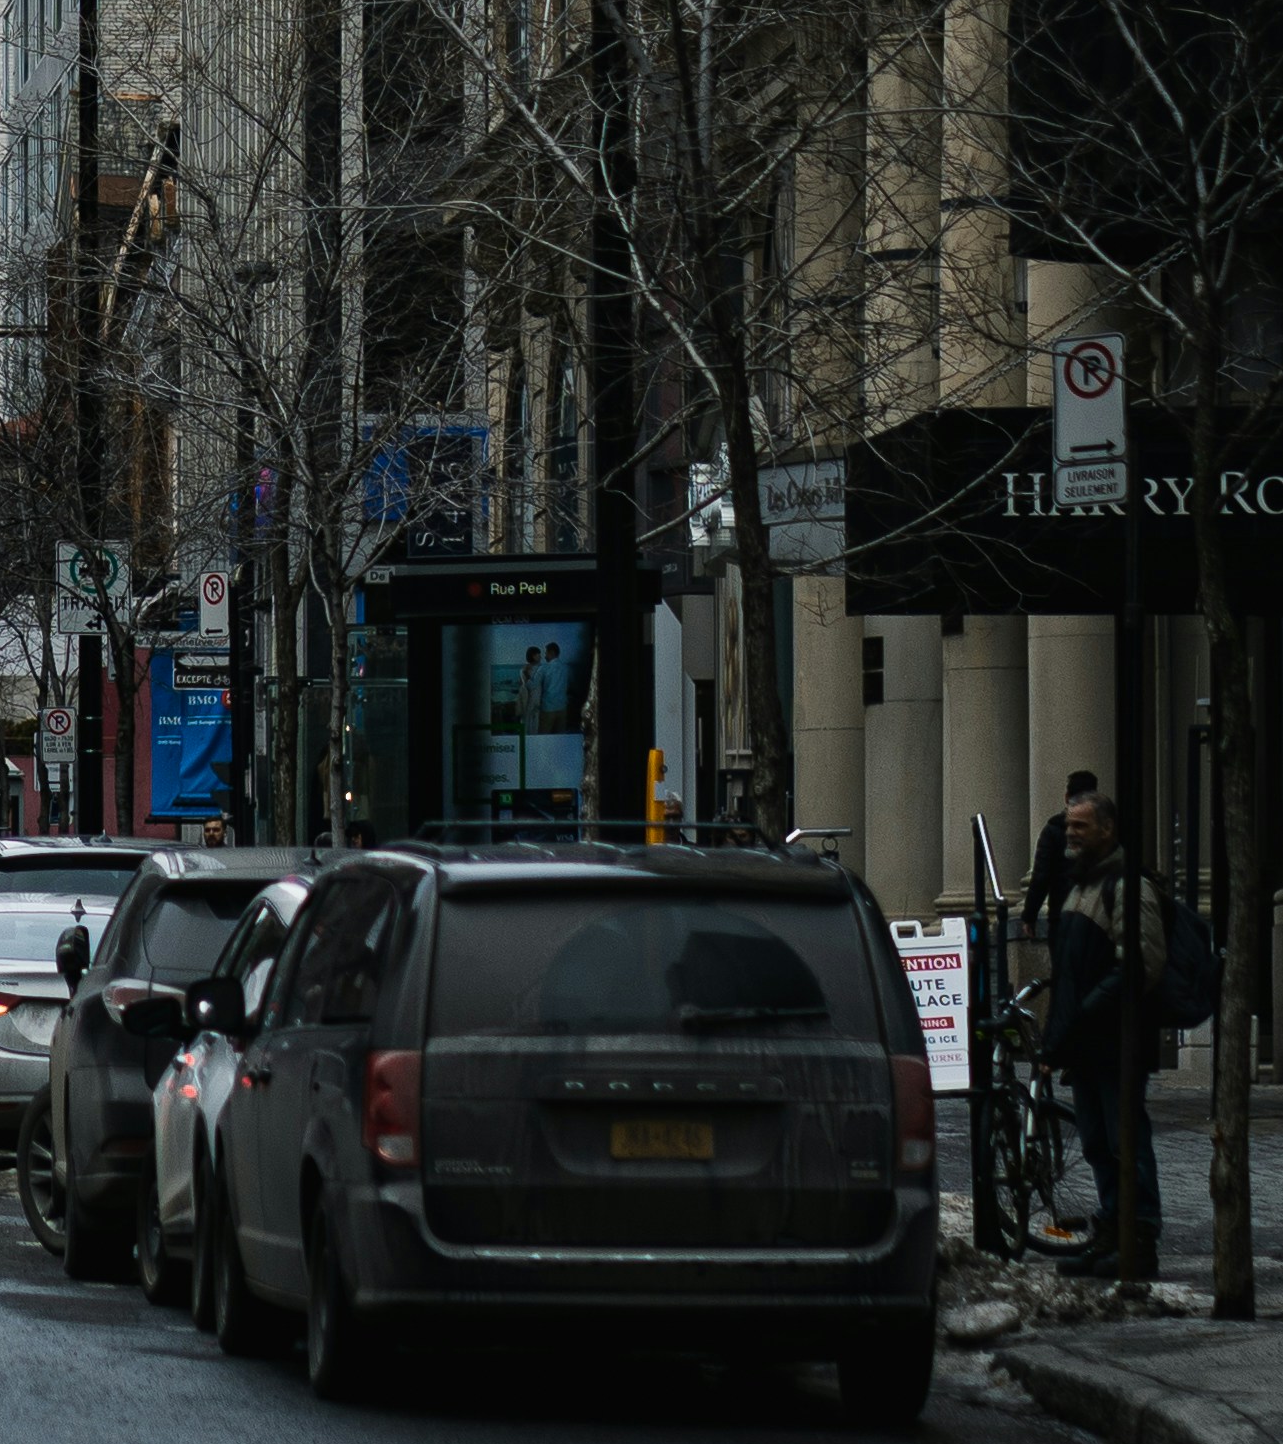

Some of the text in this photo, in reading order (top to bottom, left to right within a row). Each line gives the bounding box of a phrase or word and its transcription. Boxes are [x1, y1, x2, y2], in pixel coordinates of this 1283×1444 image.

[1067, 466, 1115, 483] LIVRAISON
[1001, 472, 1195, 516] HRY
[1064, 482, 1118, 499] SEULEMENT
[491, 581, 547, 595] Rue Peel
[188, 695, 218, 705] BMO
[910, 979, 946, 991] UTE
[916, 994, 963, 1007] LACE
[920, 1018, 948, 1028] NING
[940, 1035, 958, 1043] ICE
[928, 1053, 962, 1062] URNE
